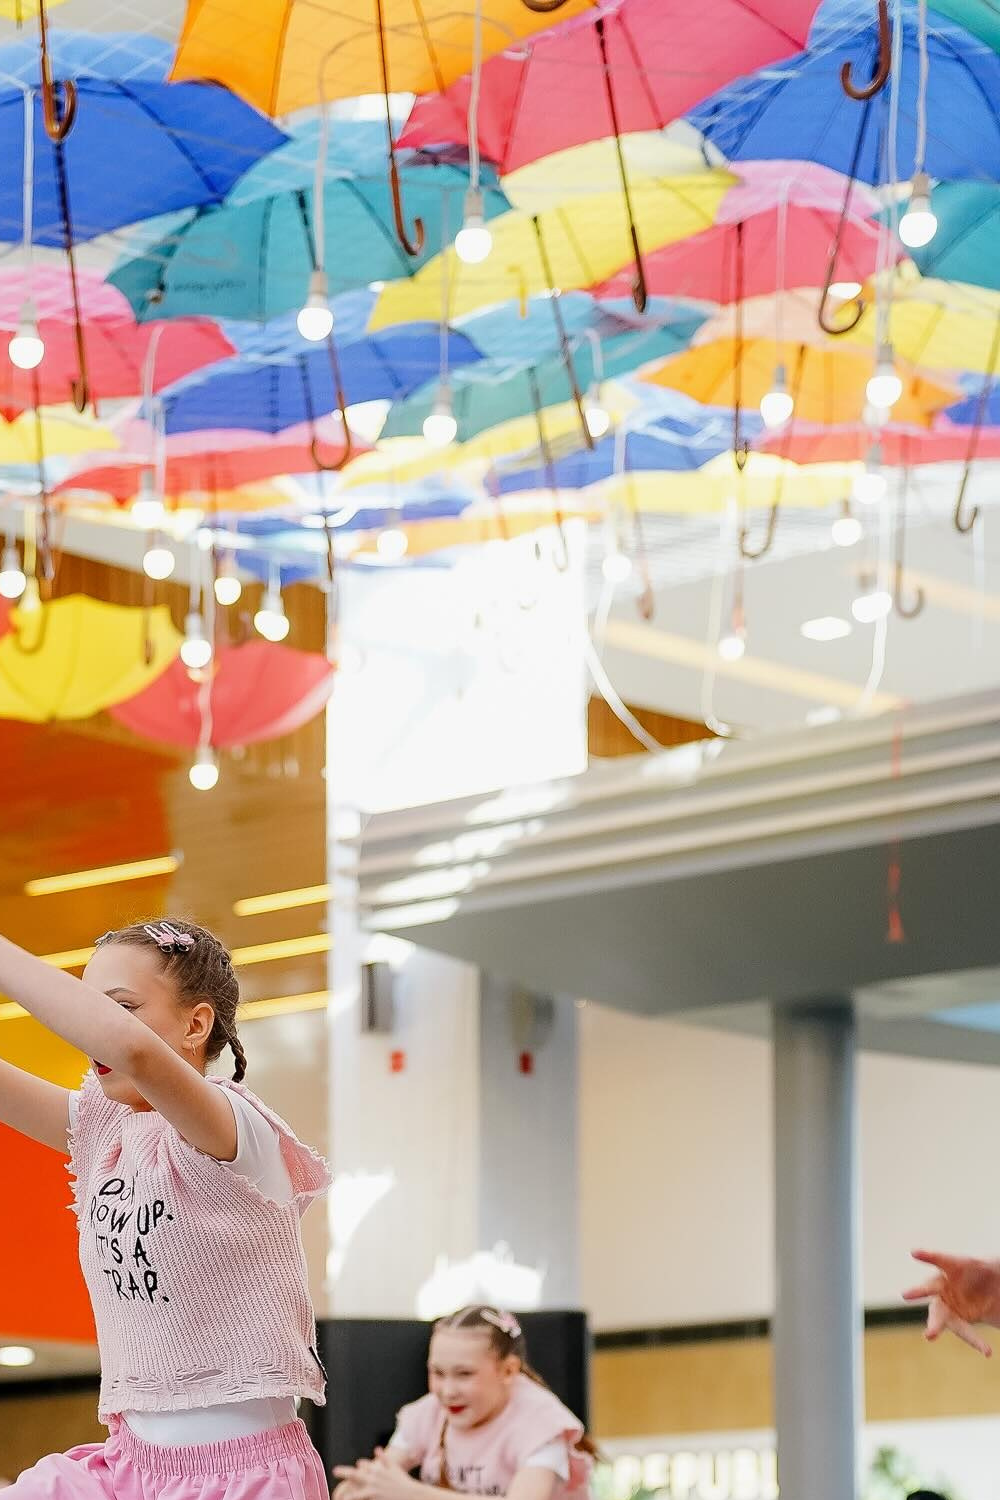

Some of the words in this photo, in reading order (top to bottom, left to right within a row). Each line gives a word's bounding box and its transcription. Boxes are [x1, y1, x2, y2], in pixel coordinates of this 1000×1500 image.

[137, 1200, 174, 1235] UP.
[133, 1236, 151, 1268] A
[103, 1269, 170, 1303] TRAP.
